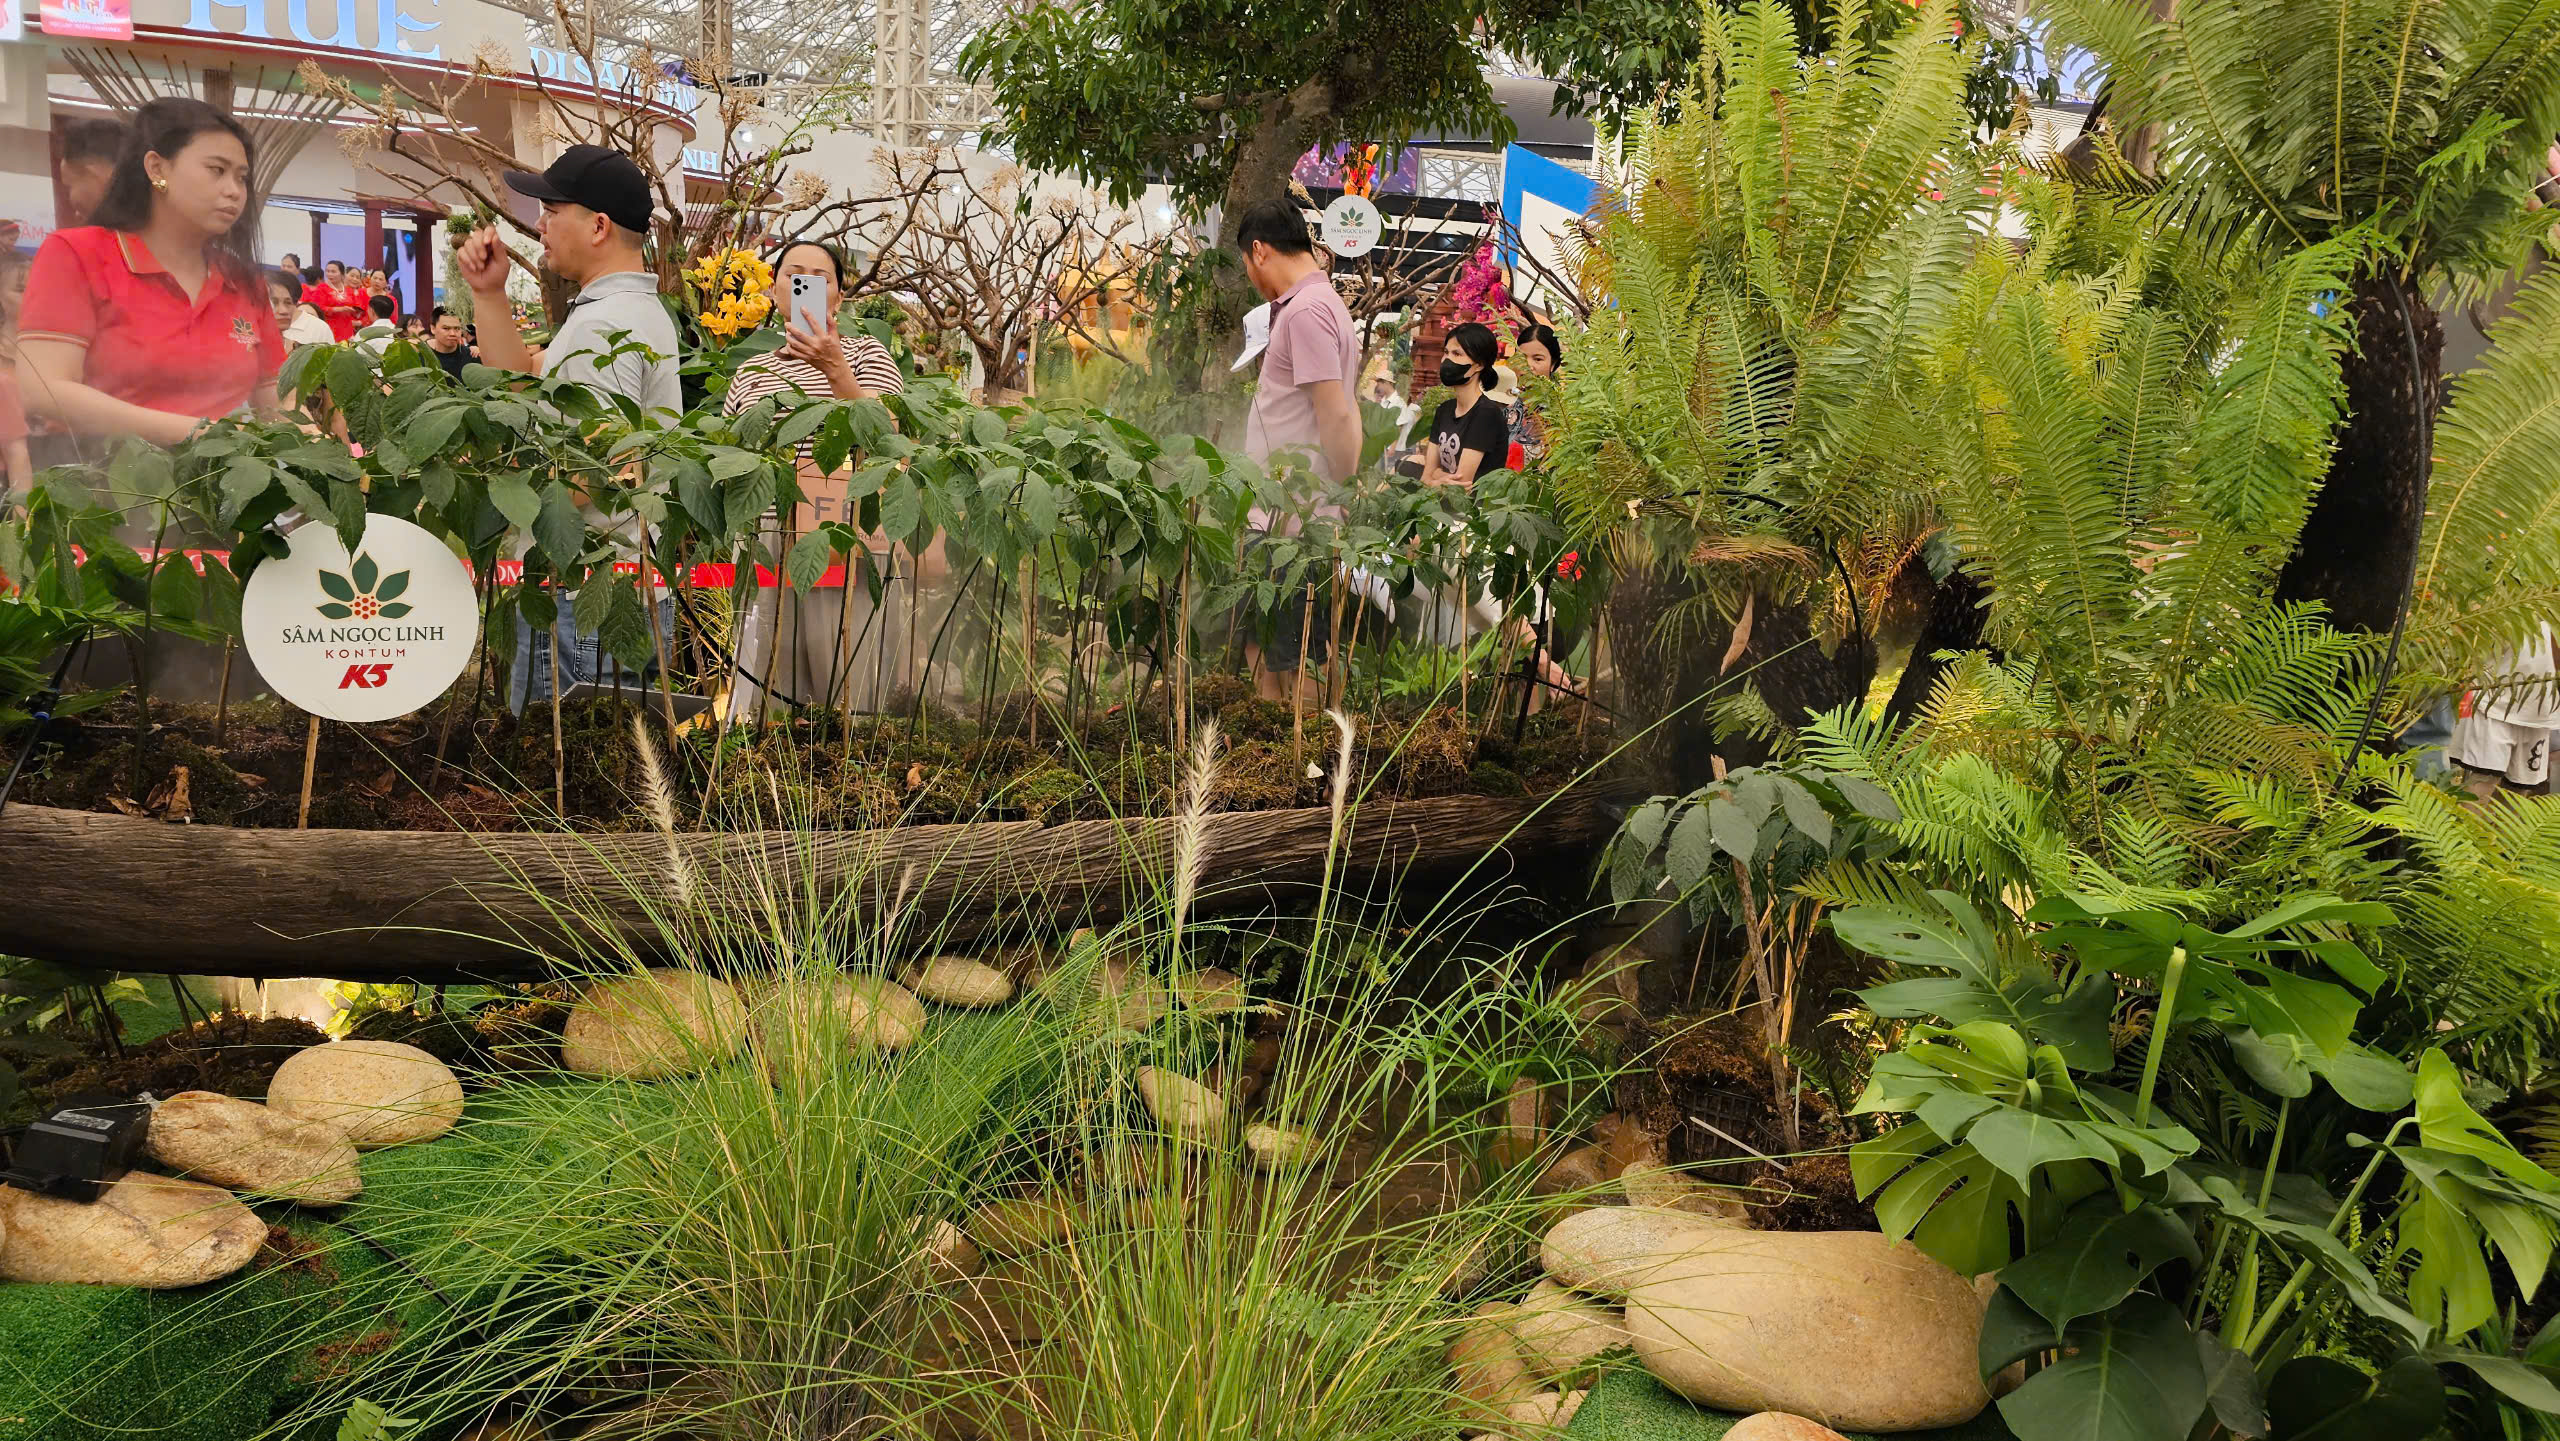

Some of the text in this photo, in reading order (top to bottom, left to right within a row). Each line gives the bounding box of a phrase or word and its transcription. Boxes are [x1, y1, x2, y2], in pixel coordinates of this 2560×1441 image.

[528, 46, 567, 82] DI
[1344, 240, 1358, 248] K5
[282, 624, 444, 645] SÂM NGỌC LINH
[325, 648, 406, 659] KONTUM
[337, 663, 394, 690] K5
